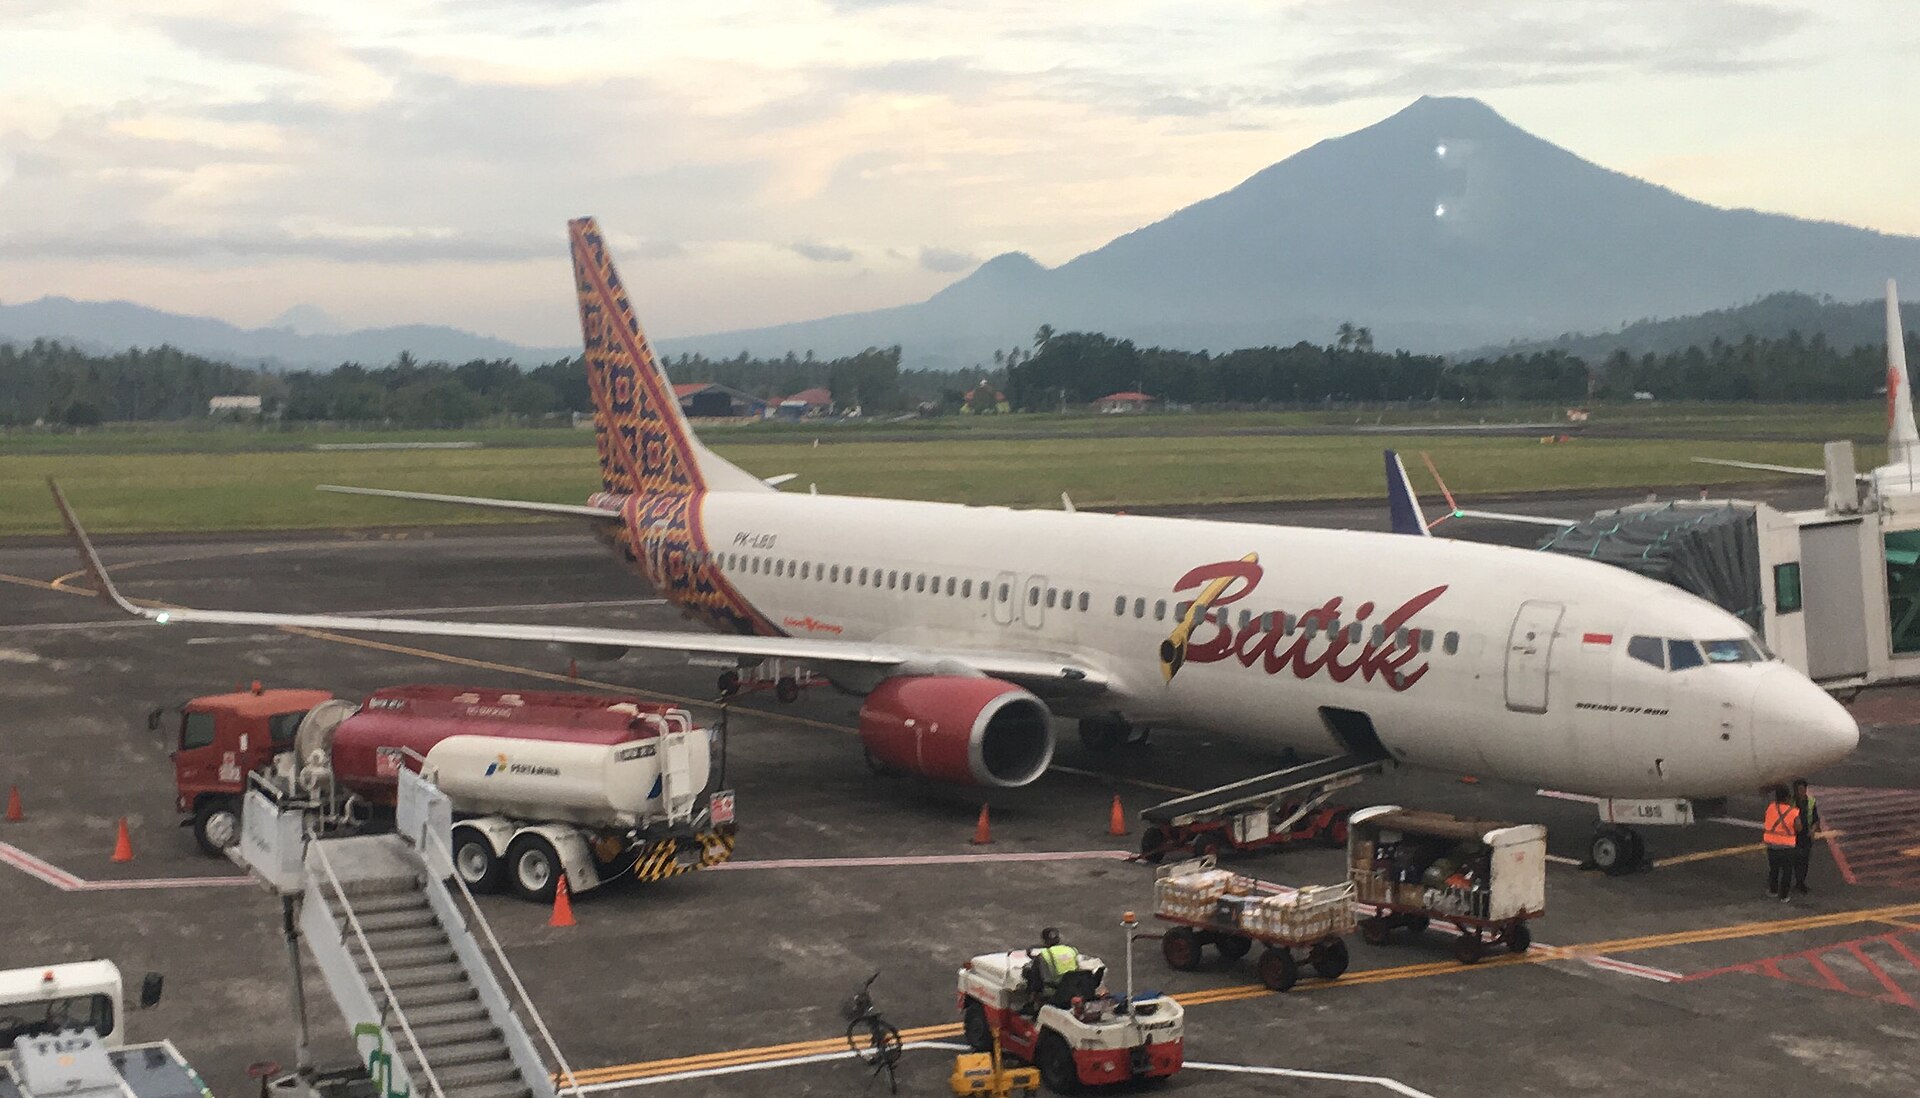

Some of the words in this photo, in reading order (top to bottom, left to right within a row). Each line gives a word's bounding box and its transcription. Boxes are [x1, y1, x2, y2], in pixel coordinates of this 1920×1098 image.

[1161, 552, 1449, 692] Batik
[1575, 702, 1617, 712] BOEING
[1620, 705, 1641, 714] 737
